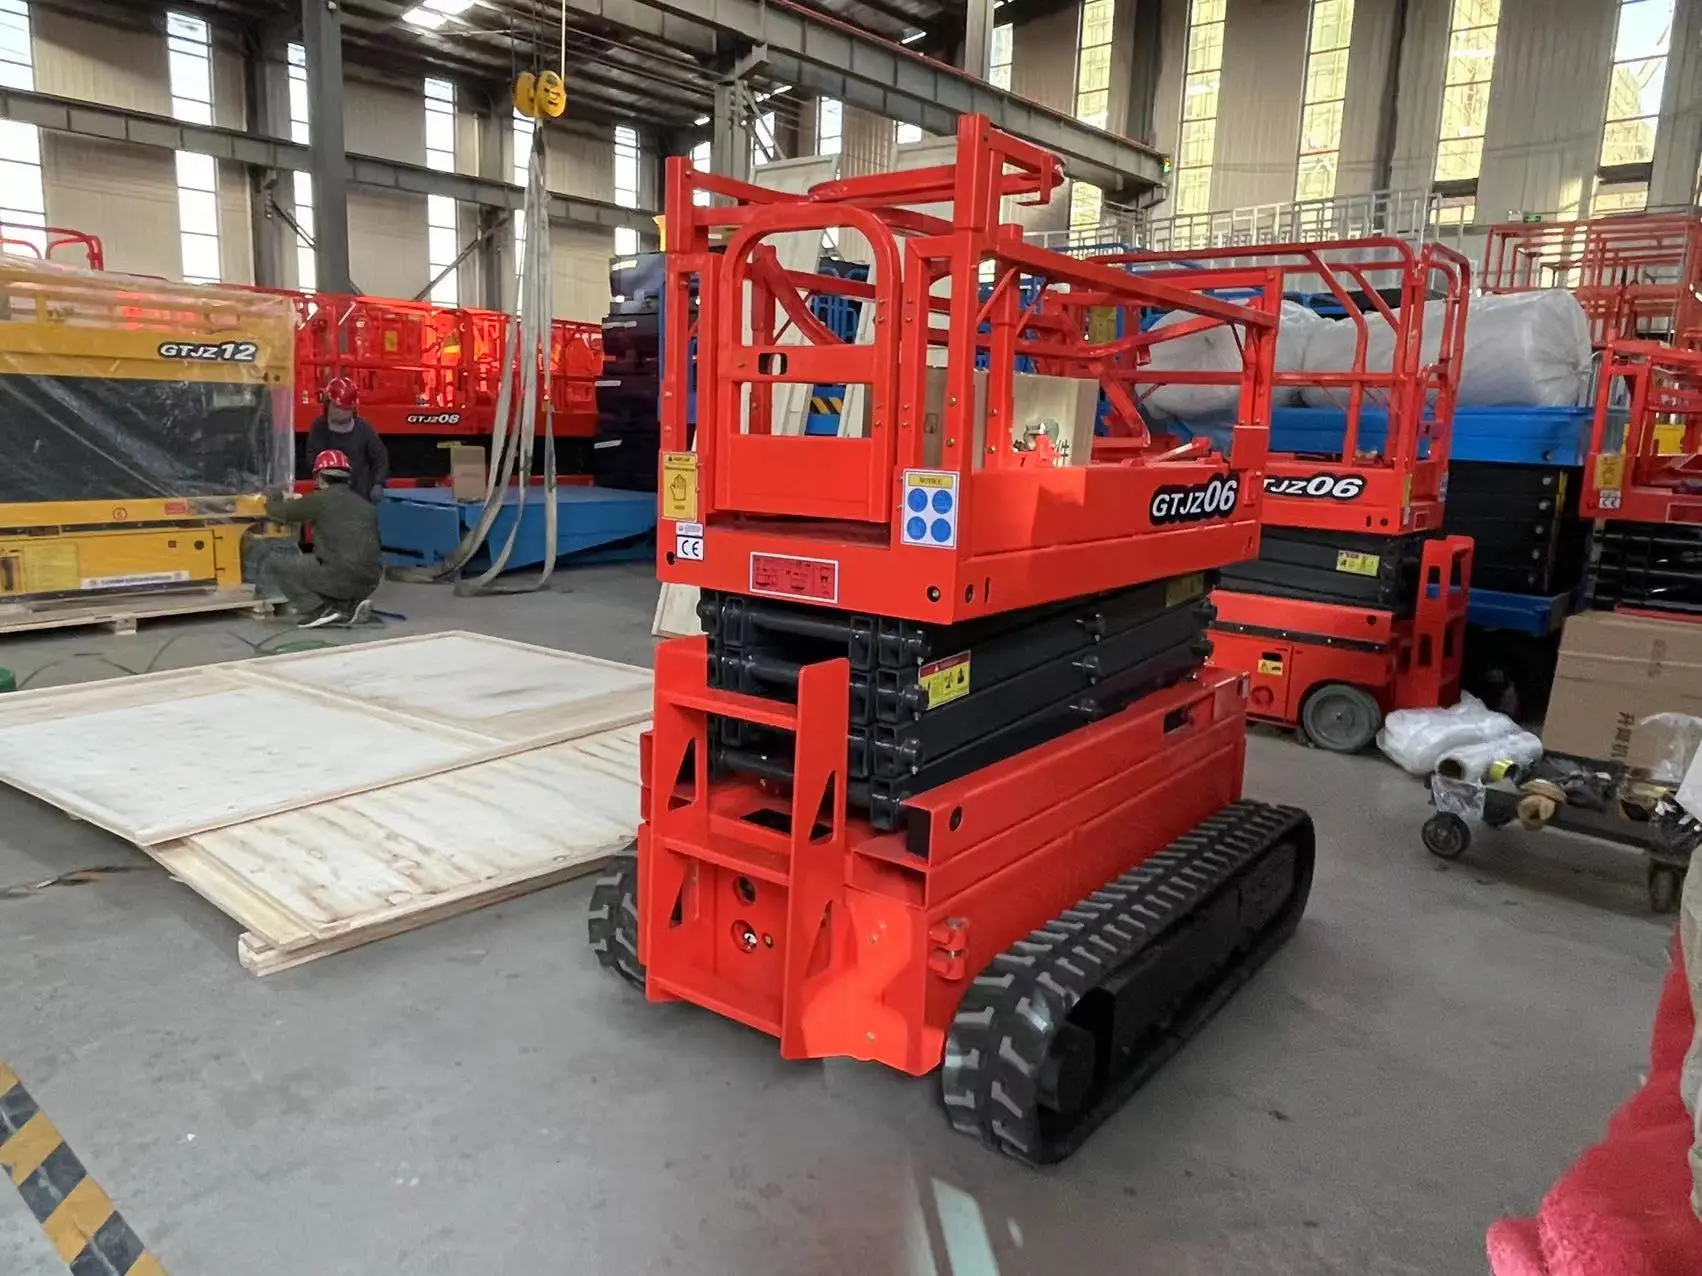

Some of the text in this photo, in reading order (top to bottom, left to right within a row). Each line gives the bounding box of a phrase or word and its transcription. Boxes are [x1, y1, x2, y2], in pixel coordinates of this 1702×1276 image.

[160, 343, 256, 360] GTJZ12
[407, 414, 460, 424] GTJZ08
[1264, 475, 1363, 498] TJZ06
[1152, 479, 1238, 517] GTJZ06
[681, 539, 700, 557] CE
